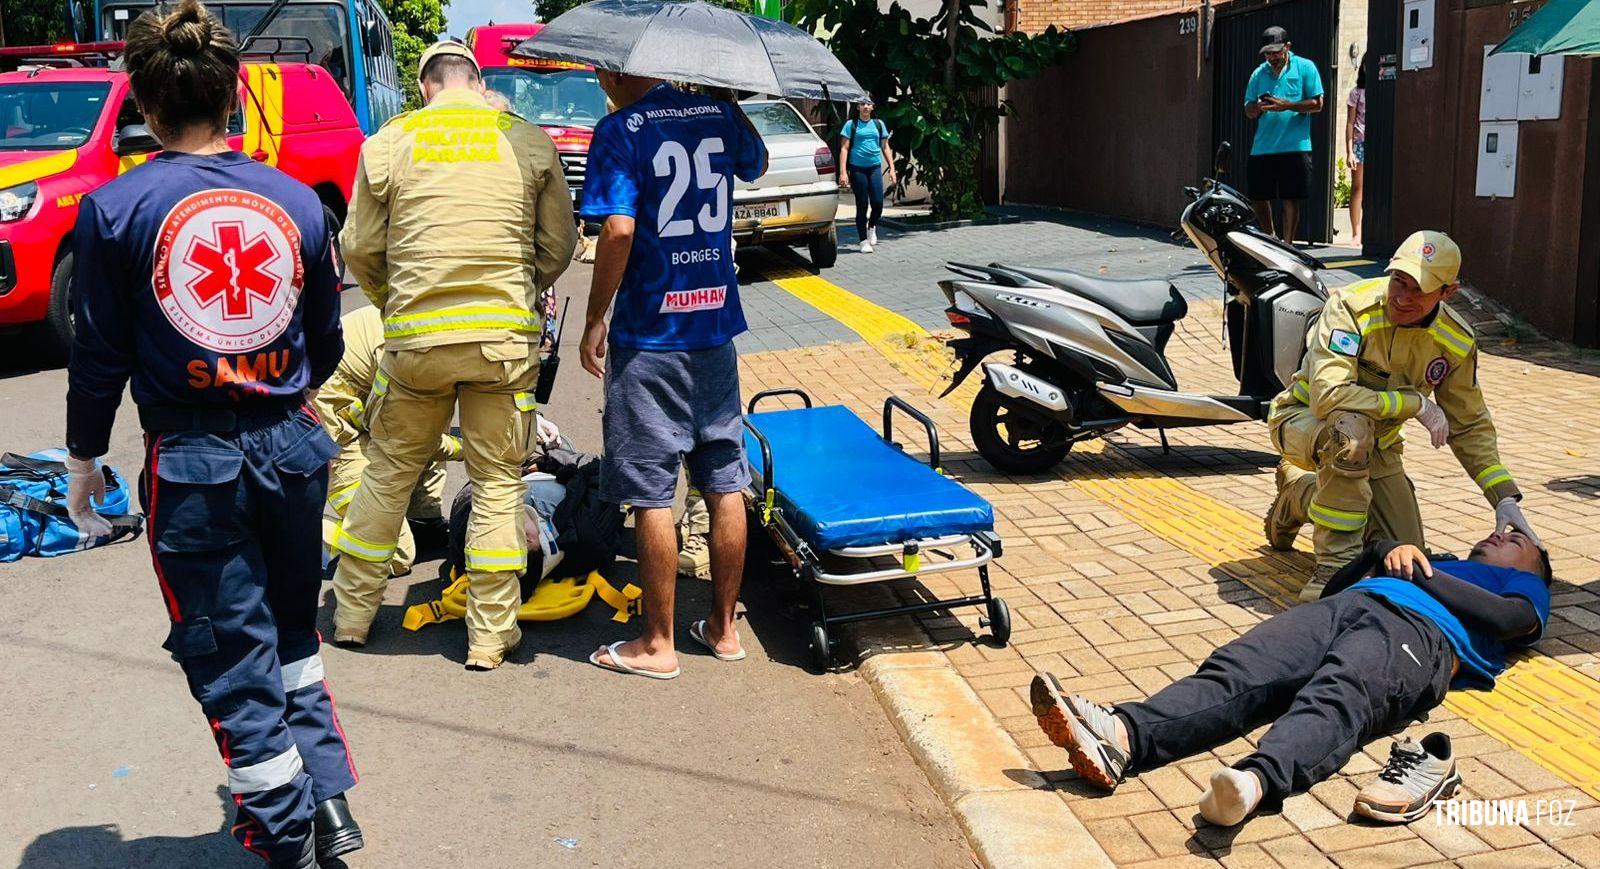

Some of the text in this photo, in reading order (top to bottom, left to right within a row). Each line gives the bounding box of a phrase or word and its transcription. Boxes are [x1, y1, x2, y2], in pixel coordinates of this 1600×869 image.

[1179, 16, 1196, 34] 239
[645, 105, 722, 119] MULTINACIONAL
[415, 130, 500, 145] MILITAR
[652, 137, 728, 238] 25
[164, 229, 174, 242] DE
[172, 195, 238, 228] ATENDIMENTO
[276, 215, 288, 228] DE
[671, 247, 721, 265] BORGES
[666, 287, 725, 307] MUNHAK
[169, 306, 211, 341] SISTEMA
[260, 330, 272, 340] DE
[187, 349, 289, 388] SAMU
